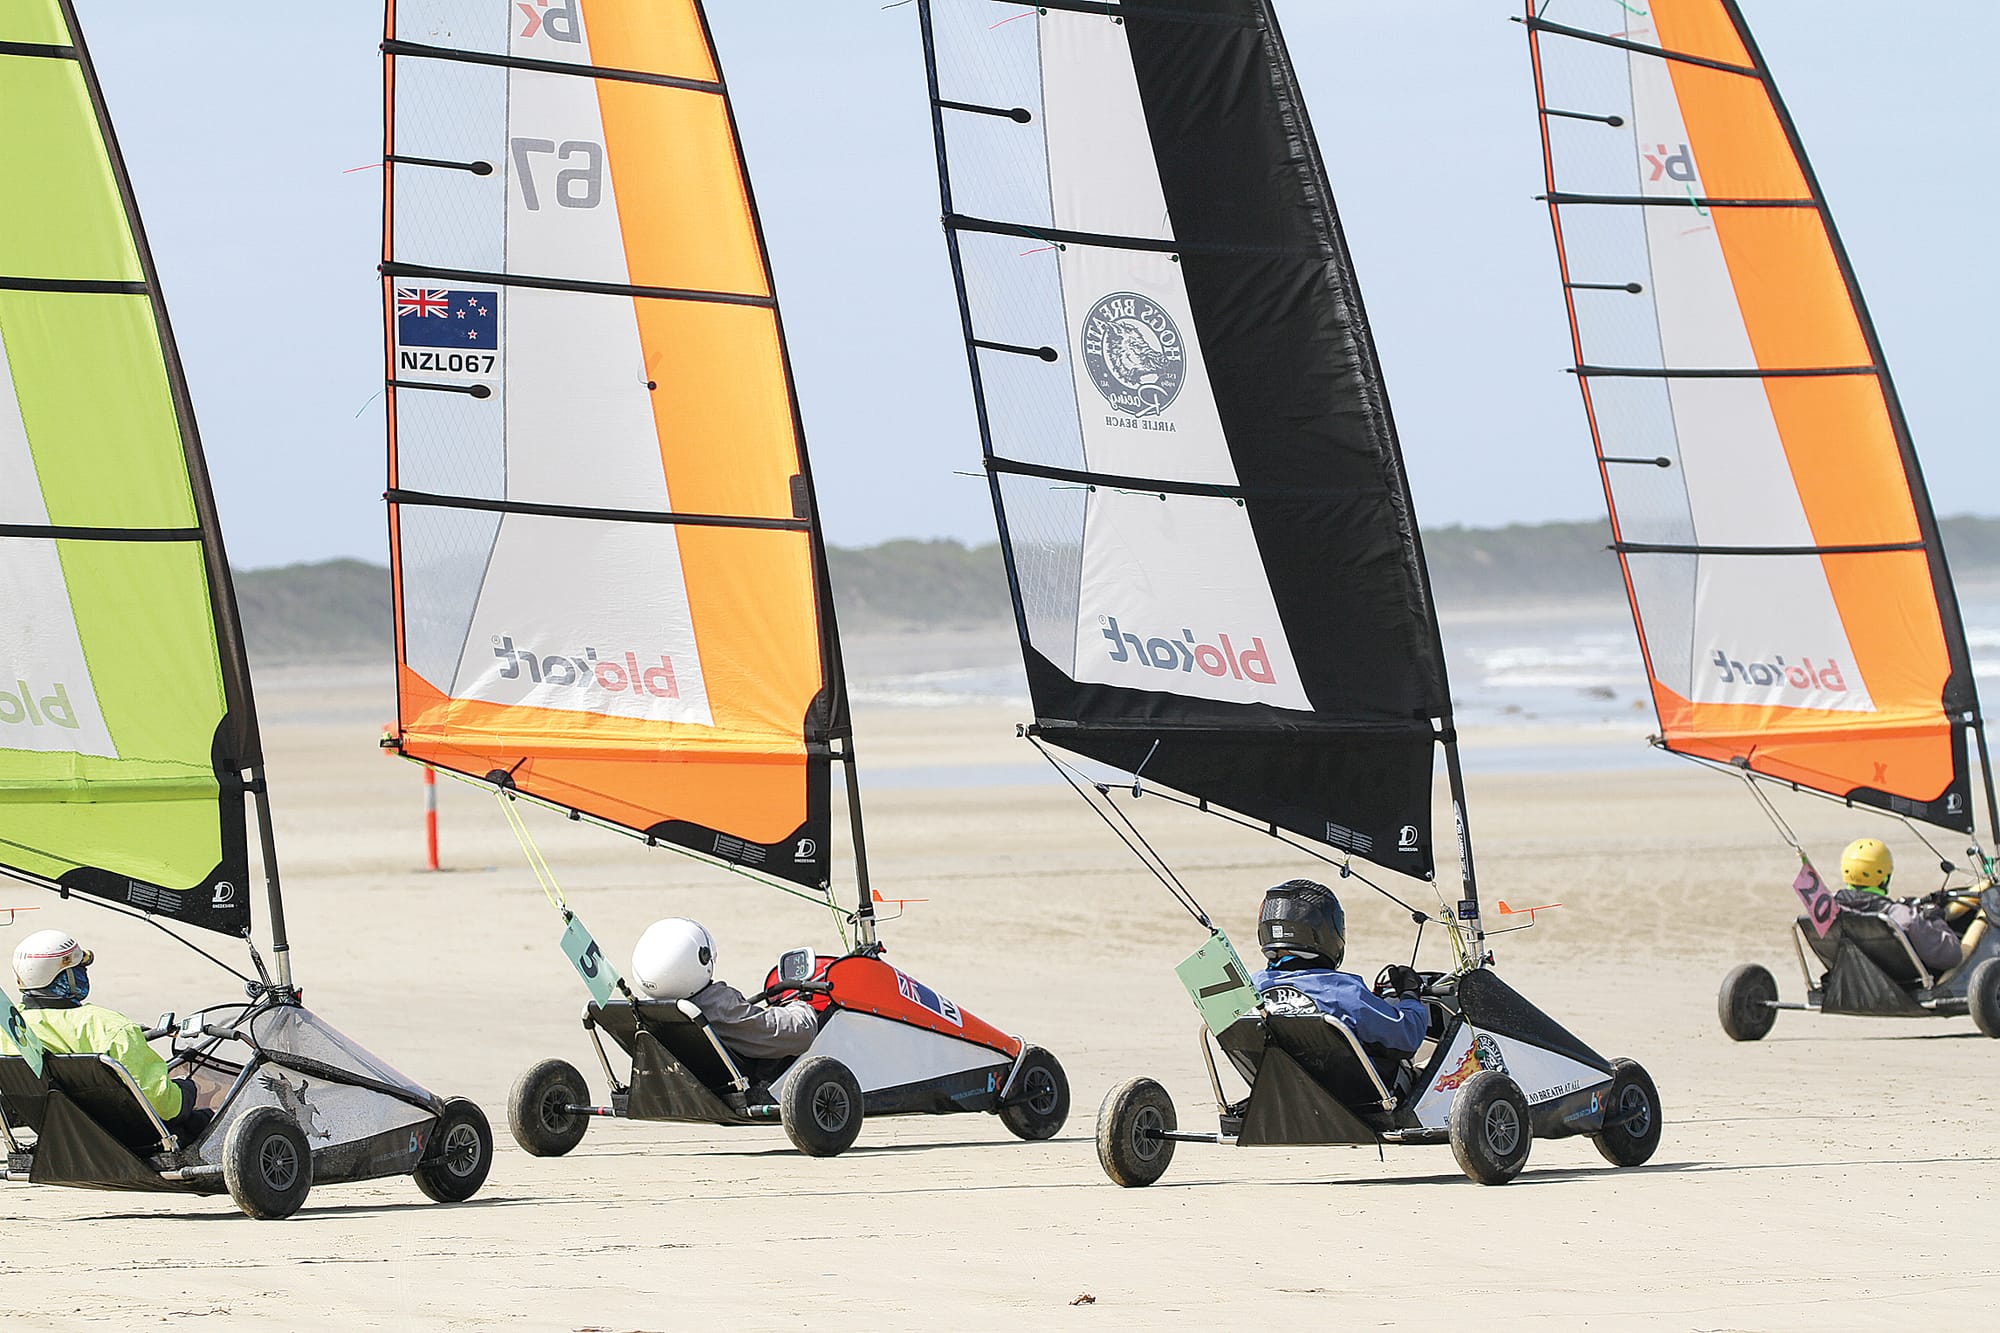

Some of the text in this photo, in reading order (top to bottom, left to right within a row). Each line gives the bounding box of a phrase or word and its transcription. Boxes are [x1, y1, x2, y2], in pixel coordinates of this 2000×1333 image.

[401, 351, 495, 374] NZL067
[1799, 871, 1833, 924] 20
[579, 940, 605, 979] 5
[1199, 961, 1246, 999] 7
[1539, 1083, 1564, 1101] BREATH
